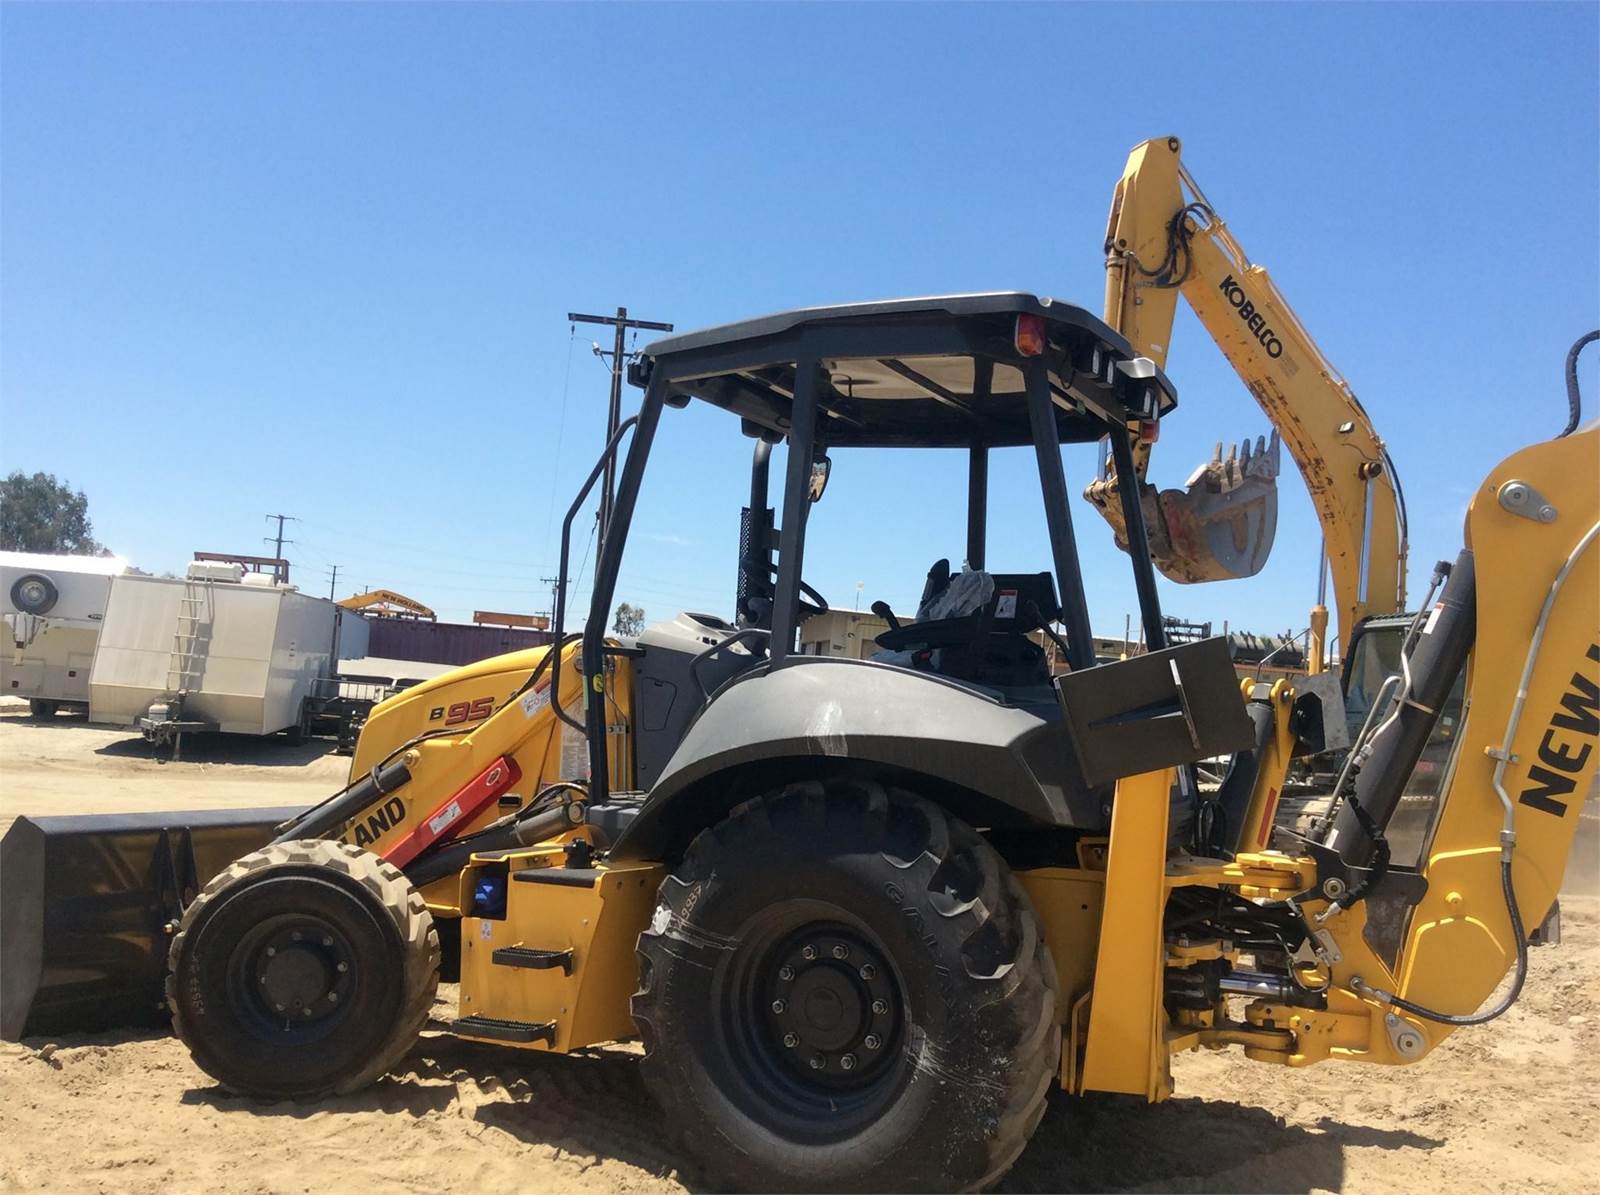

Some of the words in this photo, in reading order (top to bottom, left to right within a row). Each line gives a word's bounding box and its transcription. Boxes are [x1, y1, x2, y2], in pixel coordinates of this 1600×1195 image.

[1219, 275, 1283, 359] KOBELCO
[1518, 671, 1600, 818] NEW
[341, 797, 406, 848] AND
